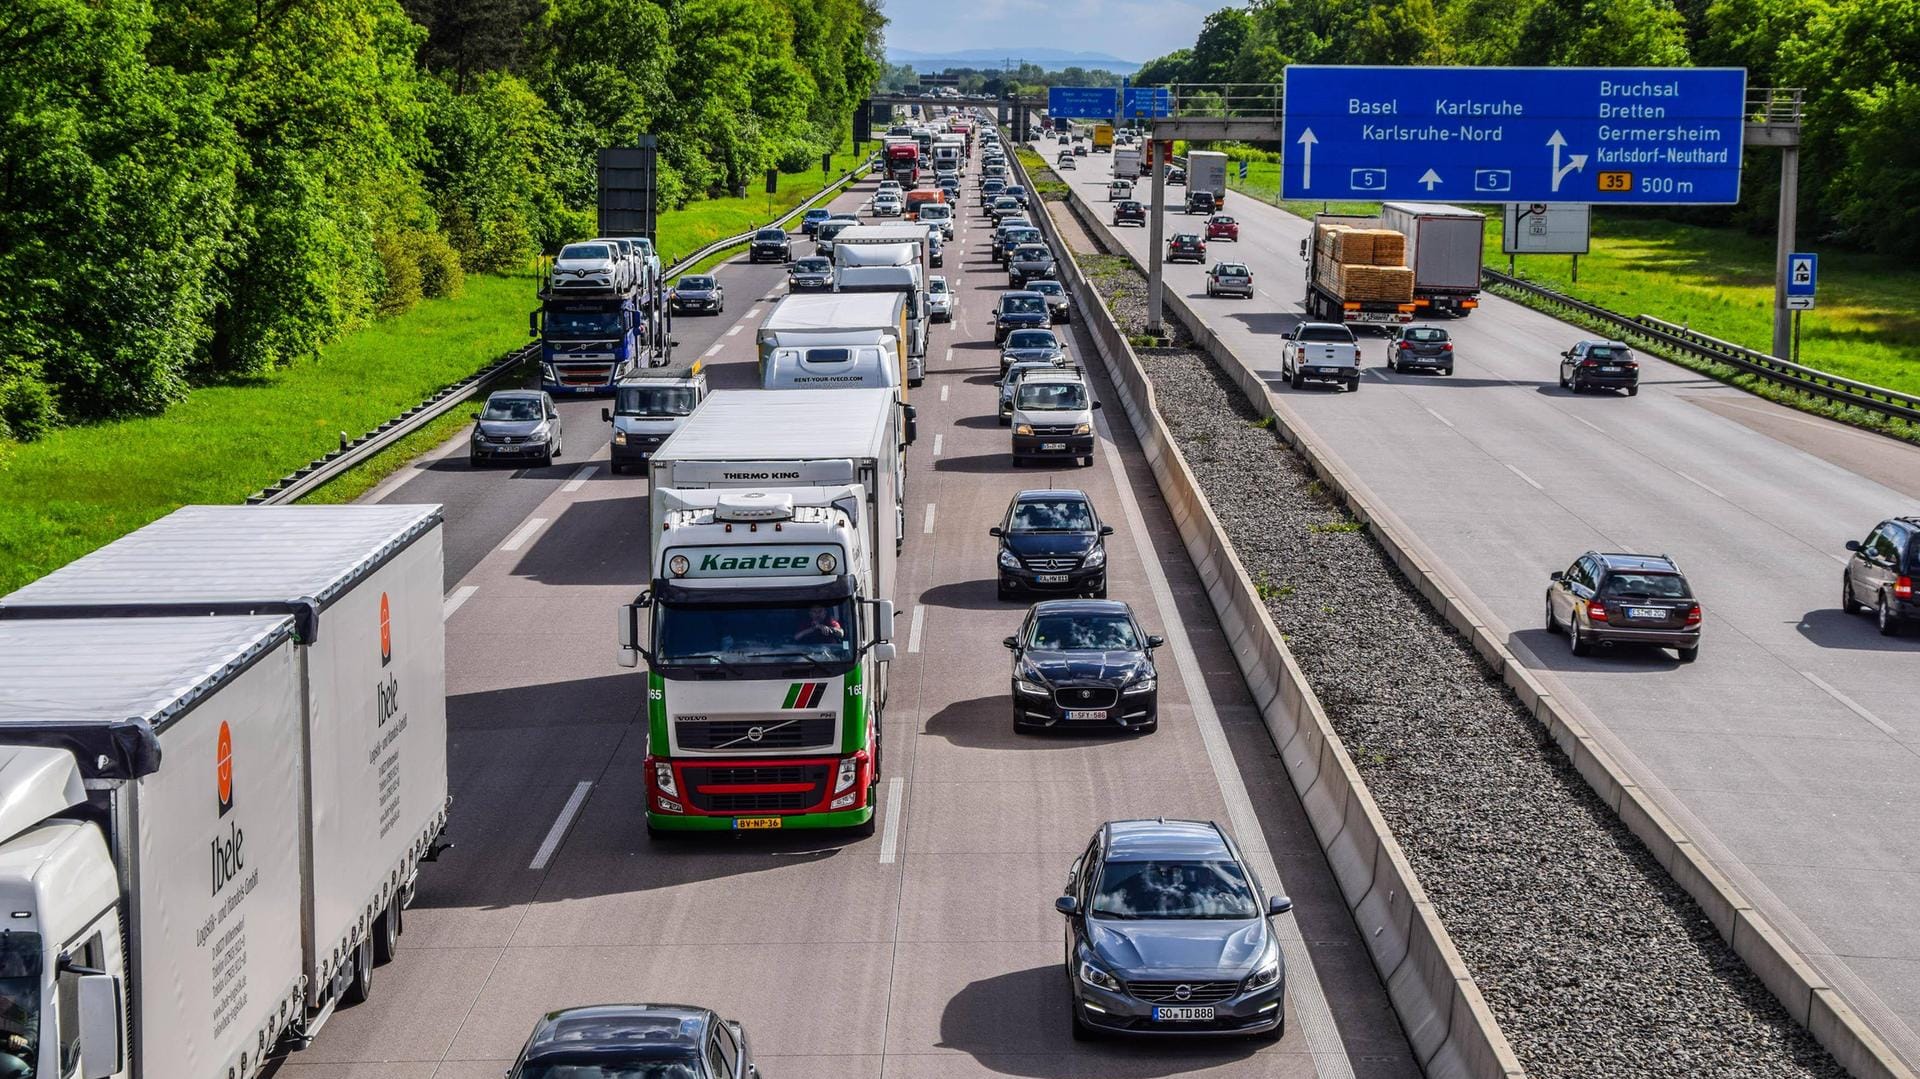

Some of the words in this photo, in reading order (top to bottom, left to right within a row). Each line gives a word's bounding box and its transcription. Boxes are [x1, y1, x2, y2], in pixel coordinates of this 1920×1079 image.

[1600, 81, 1679, 97] Bruchsal
[1349, 99, 1398, 114] Basel
[1436, 99, 1523, 115] Karlsruhe
[1600, 103, 1665, 118] Bretten
[1362, 125, 1503, 141] Karlsruhe-Nord
[1598, 125, 1721, 141] Germersheim
[1597, 147, 1728, 163] Karlsdorf-Neuthard
[1364, 173, 1373, 186] 5
[1488, 174, 1497, 187] 5
[1606, 175, 1624, 188] 35
[1641, 178, 1673, 193] 500
[1677, 181, 1693, 193] m
[723, 472, 770, 480] THERMO
[700, 553, 810, 571] Kaatee
[377, 671, 399, 728] Ibele
[740, 820, 778, 828] BV-NP-36
[211, 820, 244, 897] Ibele
[1159, 1008, 1172, 1018] SO
[1179, 1008, 1192, 1019] TD
[1194, 1008, 1213, 1019] 888
